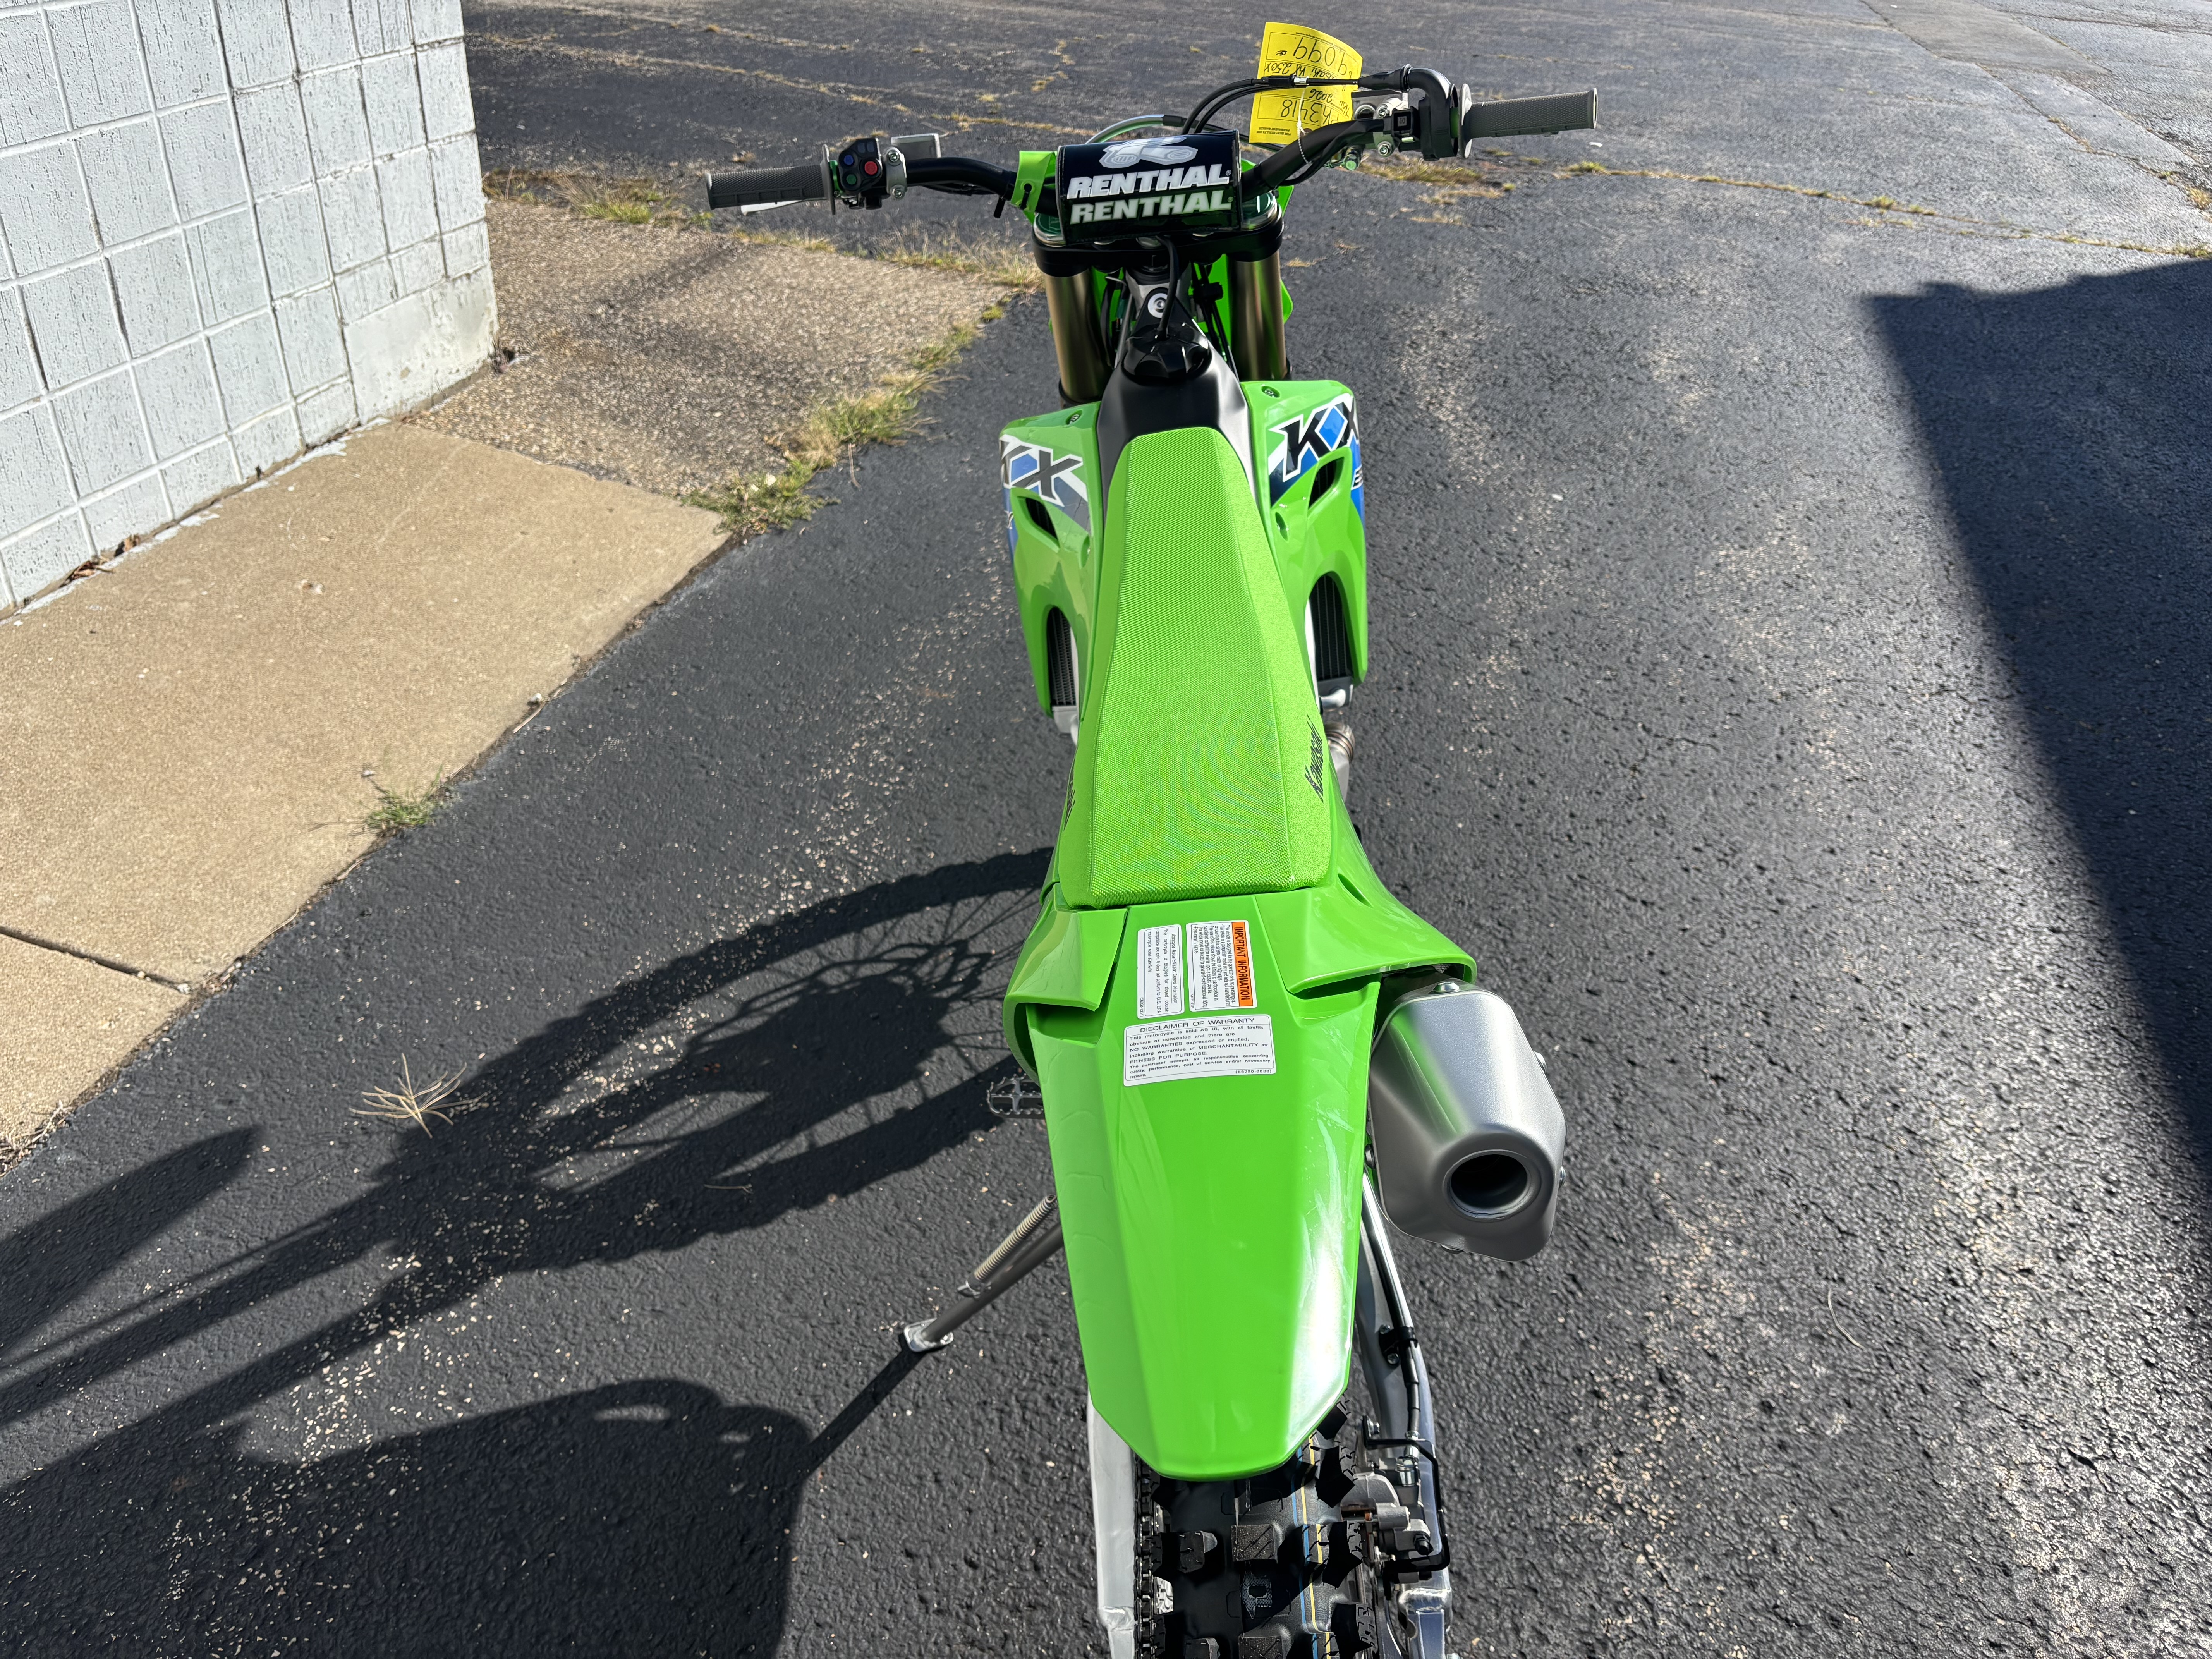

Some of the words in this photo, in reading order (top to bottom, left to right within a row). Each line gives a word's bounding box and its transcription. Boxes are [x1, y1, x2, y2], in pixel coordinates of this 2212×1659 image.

[1309, 89, 1333, 103] 2026
[1067, 164, 1229, 199] RENTHAL
[1070, 190, 1231, 225] RENTHAL
[1234, 927, 1246, 957] IMPORTANT
[1237, 960, 1250, 1000] INFORMATION
[1140, 1022, 1188, 1032] DISCLAIMER
[1142, 1042, 1182, 1050] WARRANTIES
